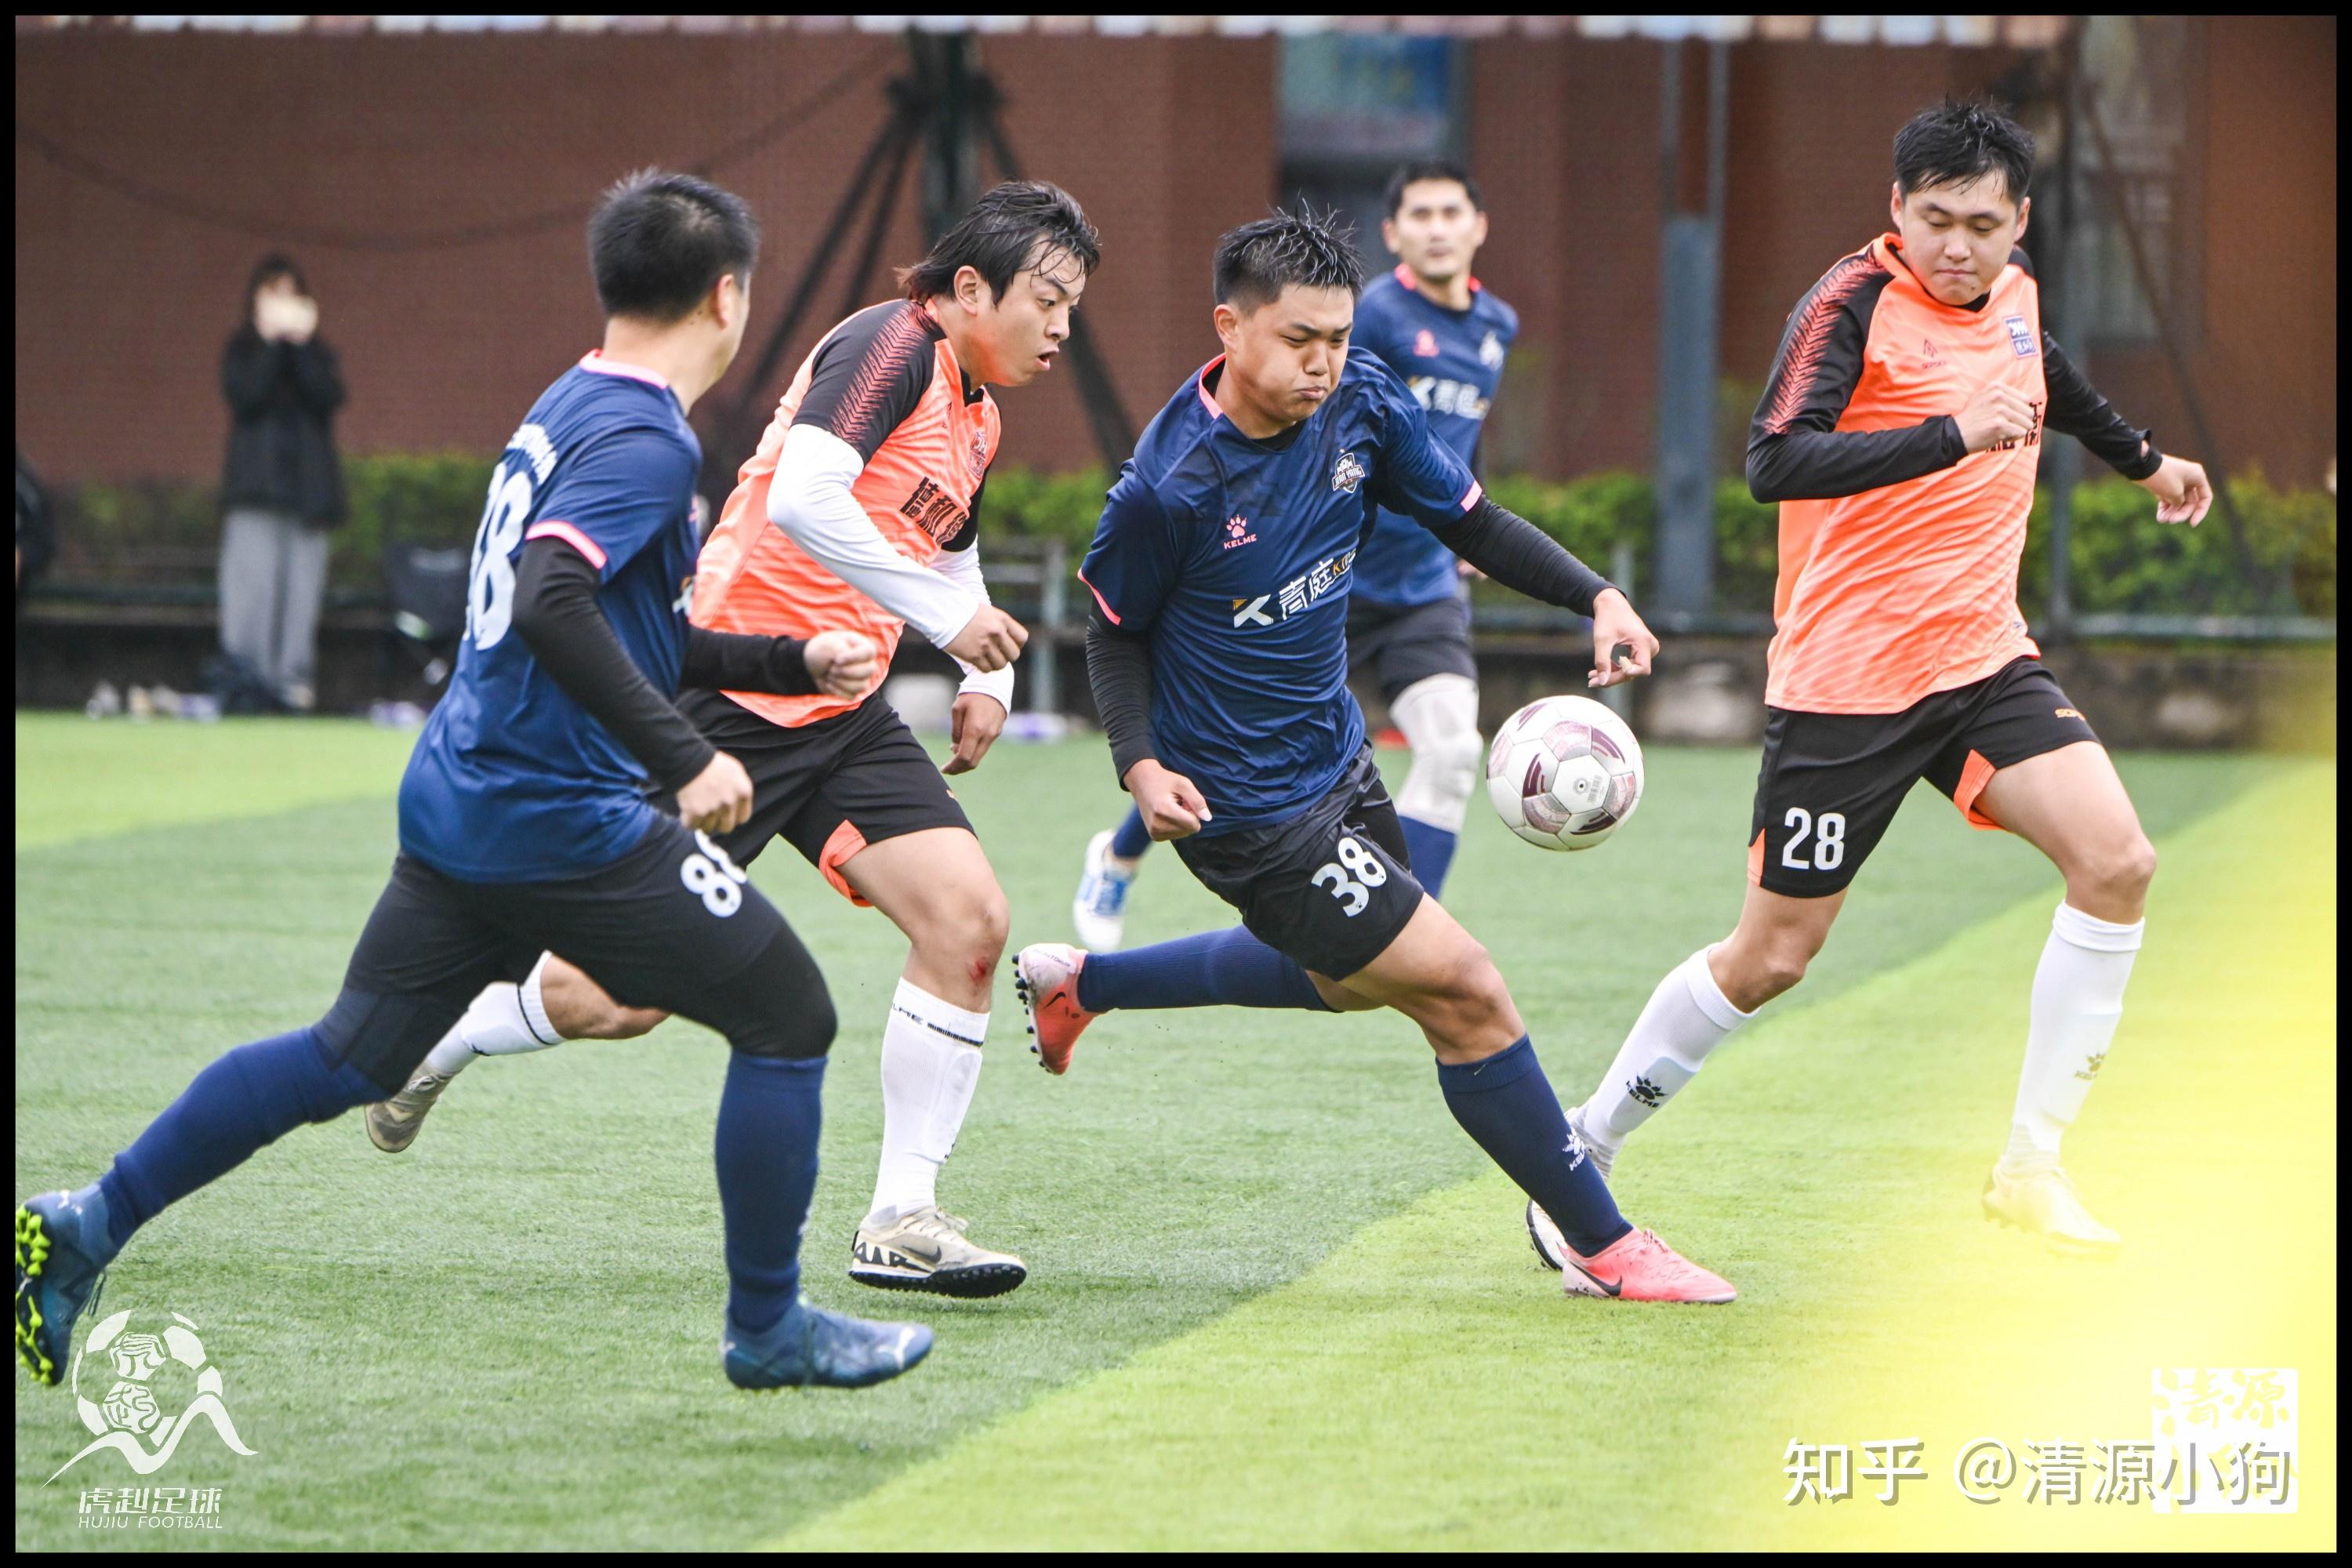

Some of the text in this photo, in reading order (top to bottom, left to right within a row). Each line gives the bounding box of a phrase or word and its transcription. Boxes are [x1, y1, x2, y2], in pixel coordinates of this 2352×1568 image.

[1223, 533, 1258, 550] KELME
[1782, 807, 1846, 870] 28
[1311, 837, 1387, 917] 38
